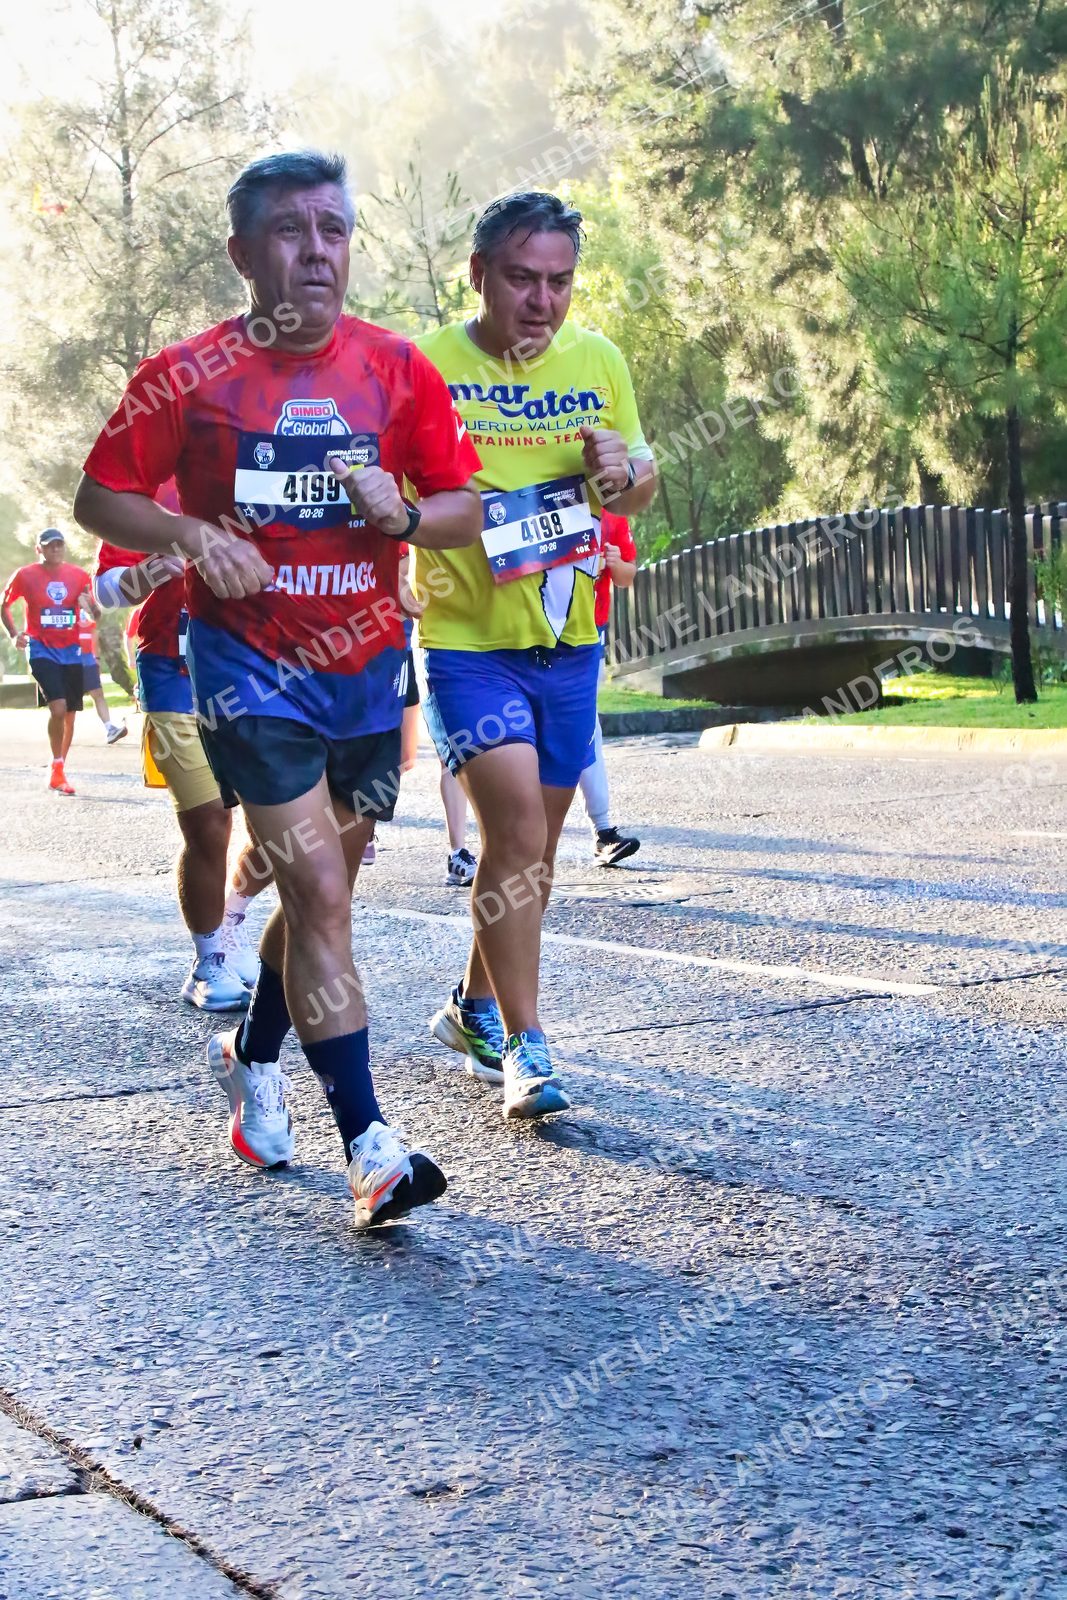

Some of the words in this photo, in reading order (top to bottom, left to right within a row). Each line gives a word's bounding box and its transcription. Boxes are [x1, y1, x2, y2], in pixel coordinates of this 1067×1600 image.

[290, 406, 331, 417] BIMBO
[293, 420, 331, 436] Global
[463, 419, 523, 433] UERTO
[527, 415, 601, 432] VALLARTA
[473, 435, 547, 447] RAINING
[554, 431, 584, 444] TEA
[282, 474, 341, 503] 4199
[347, 519, 366, 529] 10K
[520, 512, 564, 543] 4198
[575, 544, 591, 555] 10K
